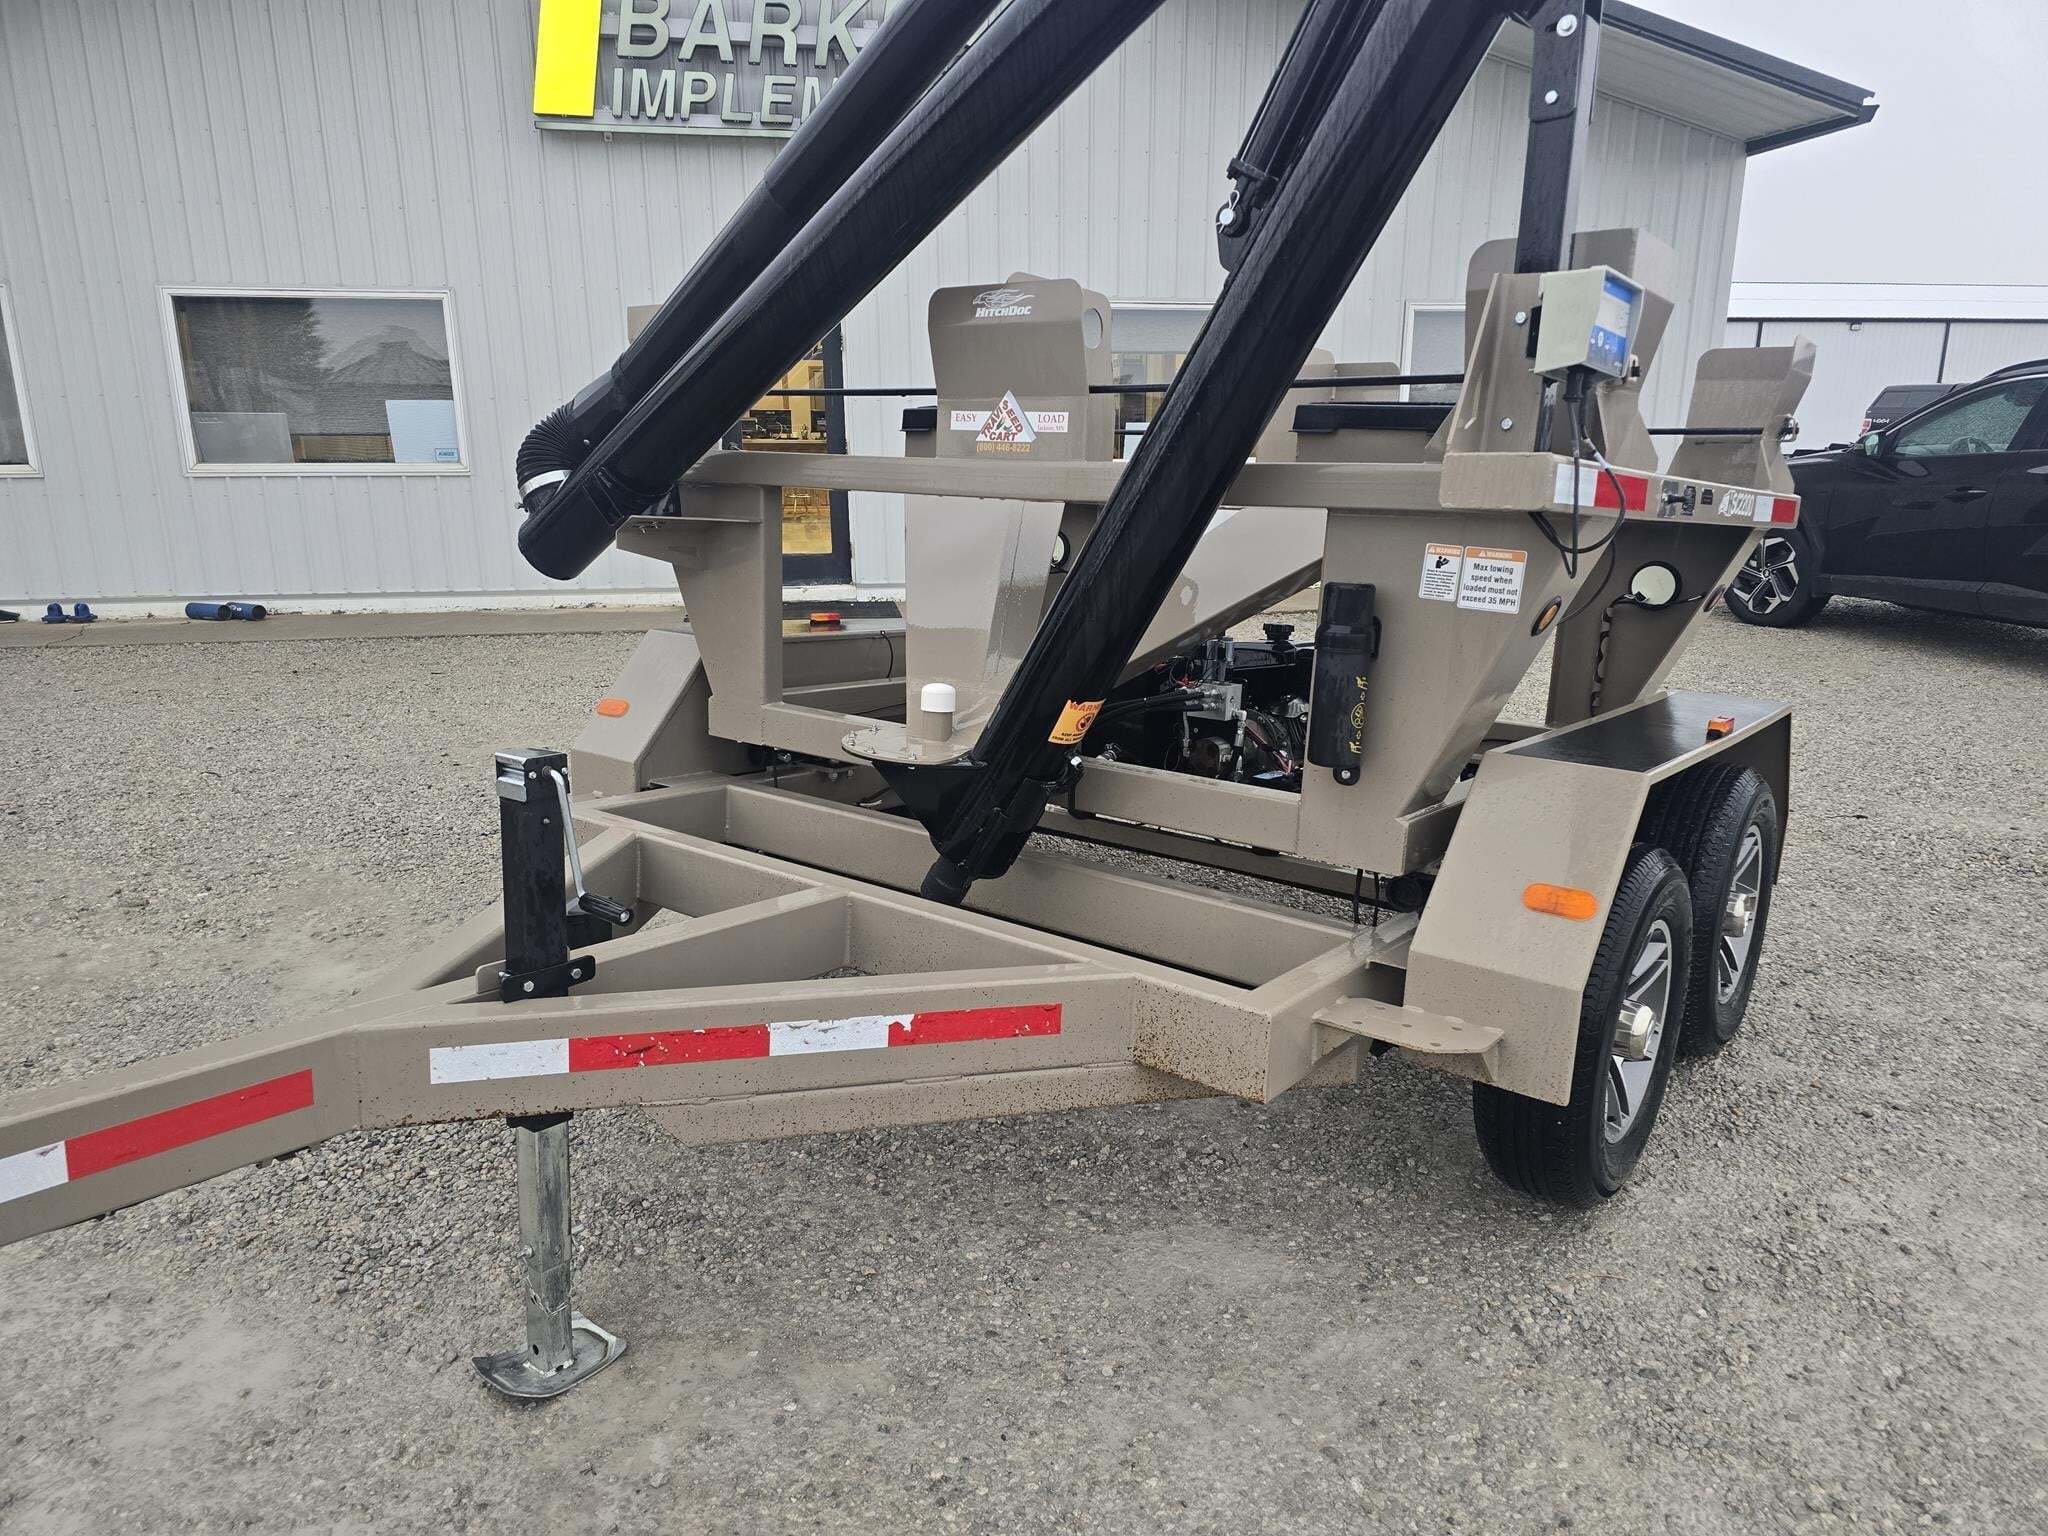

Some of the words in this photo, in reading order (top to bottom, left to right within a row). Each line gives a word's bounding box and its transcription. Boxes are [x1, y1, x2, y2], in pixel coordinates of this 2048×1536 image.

[616, 0, 897, 68] BARK
[955, 413, 976, 422] EASY
[1038, 414, 1065, 423] LOAD
[989, 431, 1018, 441] CART
[1473, 563, 1488, 571] Max
[1490, 565, 1514, 575] towing
[1471, 575, 1492, 583] speed
[1494, 576, 1513, 585] when
[1463, 584, 1487, 593] loaded
[1488, 587, 1505, 595] must
[1462, 596, 1487, 604] exceed
[1488, 597, 1497, 605] 35
[1499, 598, 1516, 606] MPH
